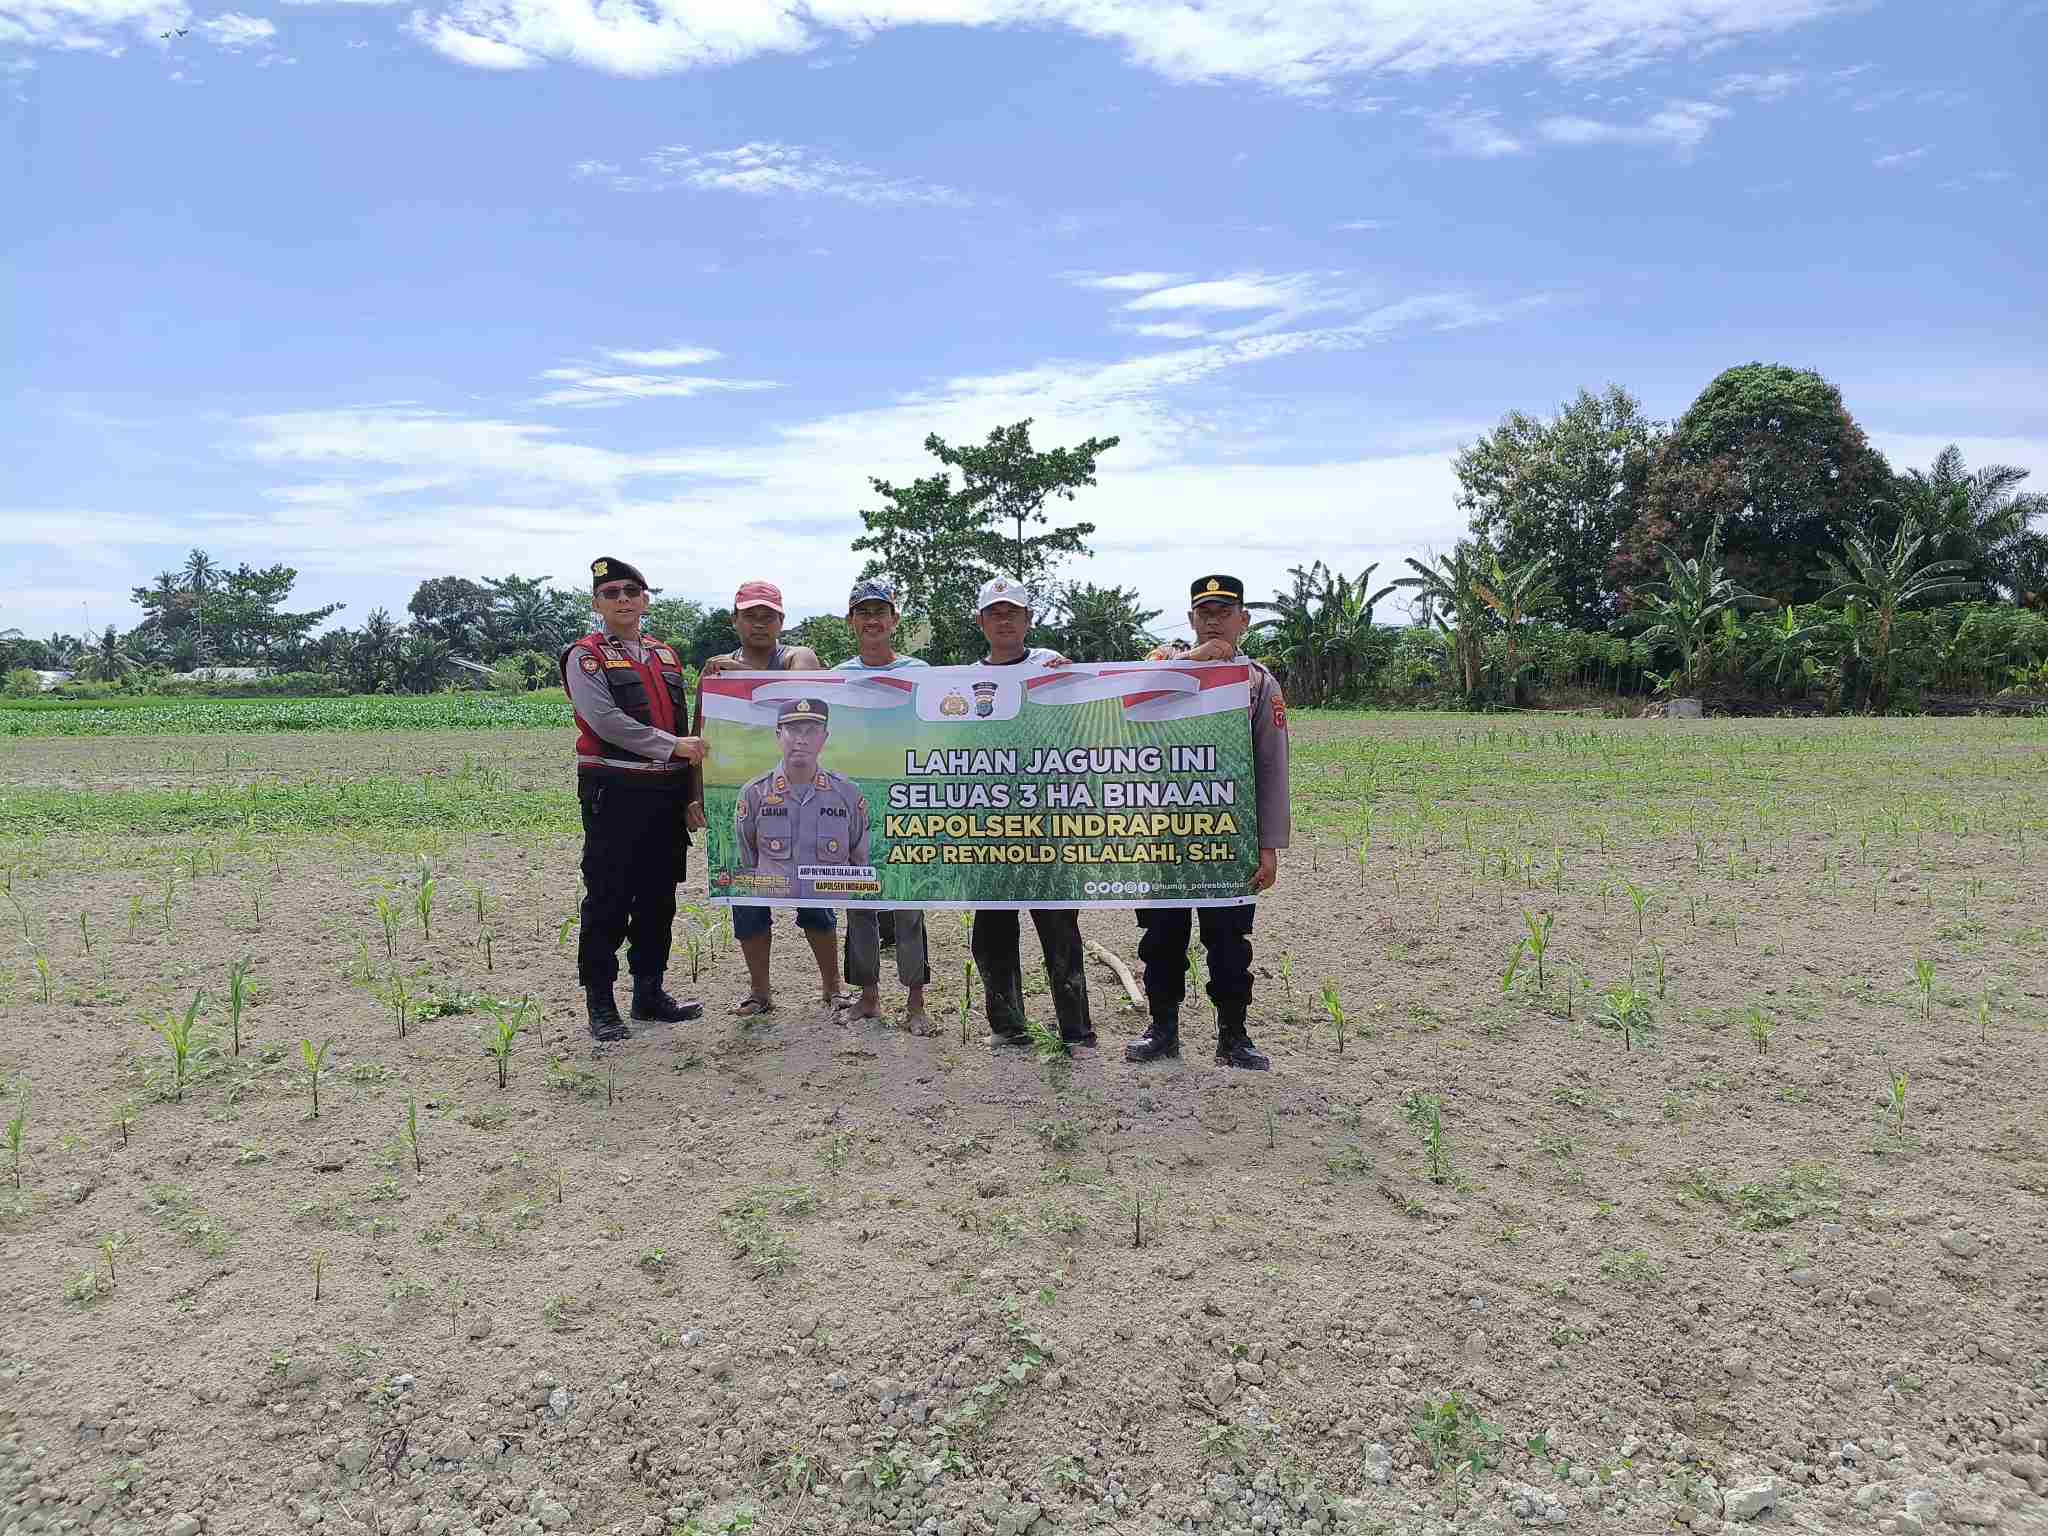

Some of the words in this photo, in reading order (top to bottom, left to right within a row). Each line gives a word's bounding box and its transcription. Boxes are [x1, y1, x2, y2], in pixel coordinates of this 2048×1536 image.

[906, 749, 1017, 776] LAHAN
[1024, 747, 1162, 775] JAGUNG
[1169, 745, 1217, 773] INI
[889, 783, 1011, 808] SELUAS
[1018, 784, 1038, 808] 3
[1046, 783, 1097, 808] HA
[1104, 780, 1235, 808] BINAAN
[885, 815, 1044, 838] KAPOLSEK
[1052, 812, 1239, 837] INDRAPURA
[888, 845, 937, 864] AKP
[943, 844, 1056, 864] REYNOLD
[1062, 843, 1183, 865] SILALAHI,
[1187, 841, 1235, 862] S.H.
